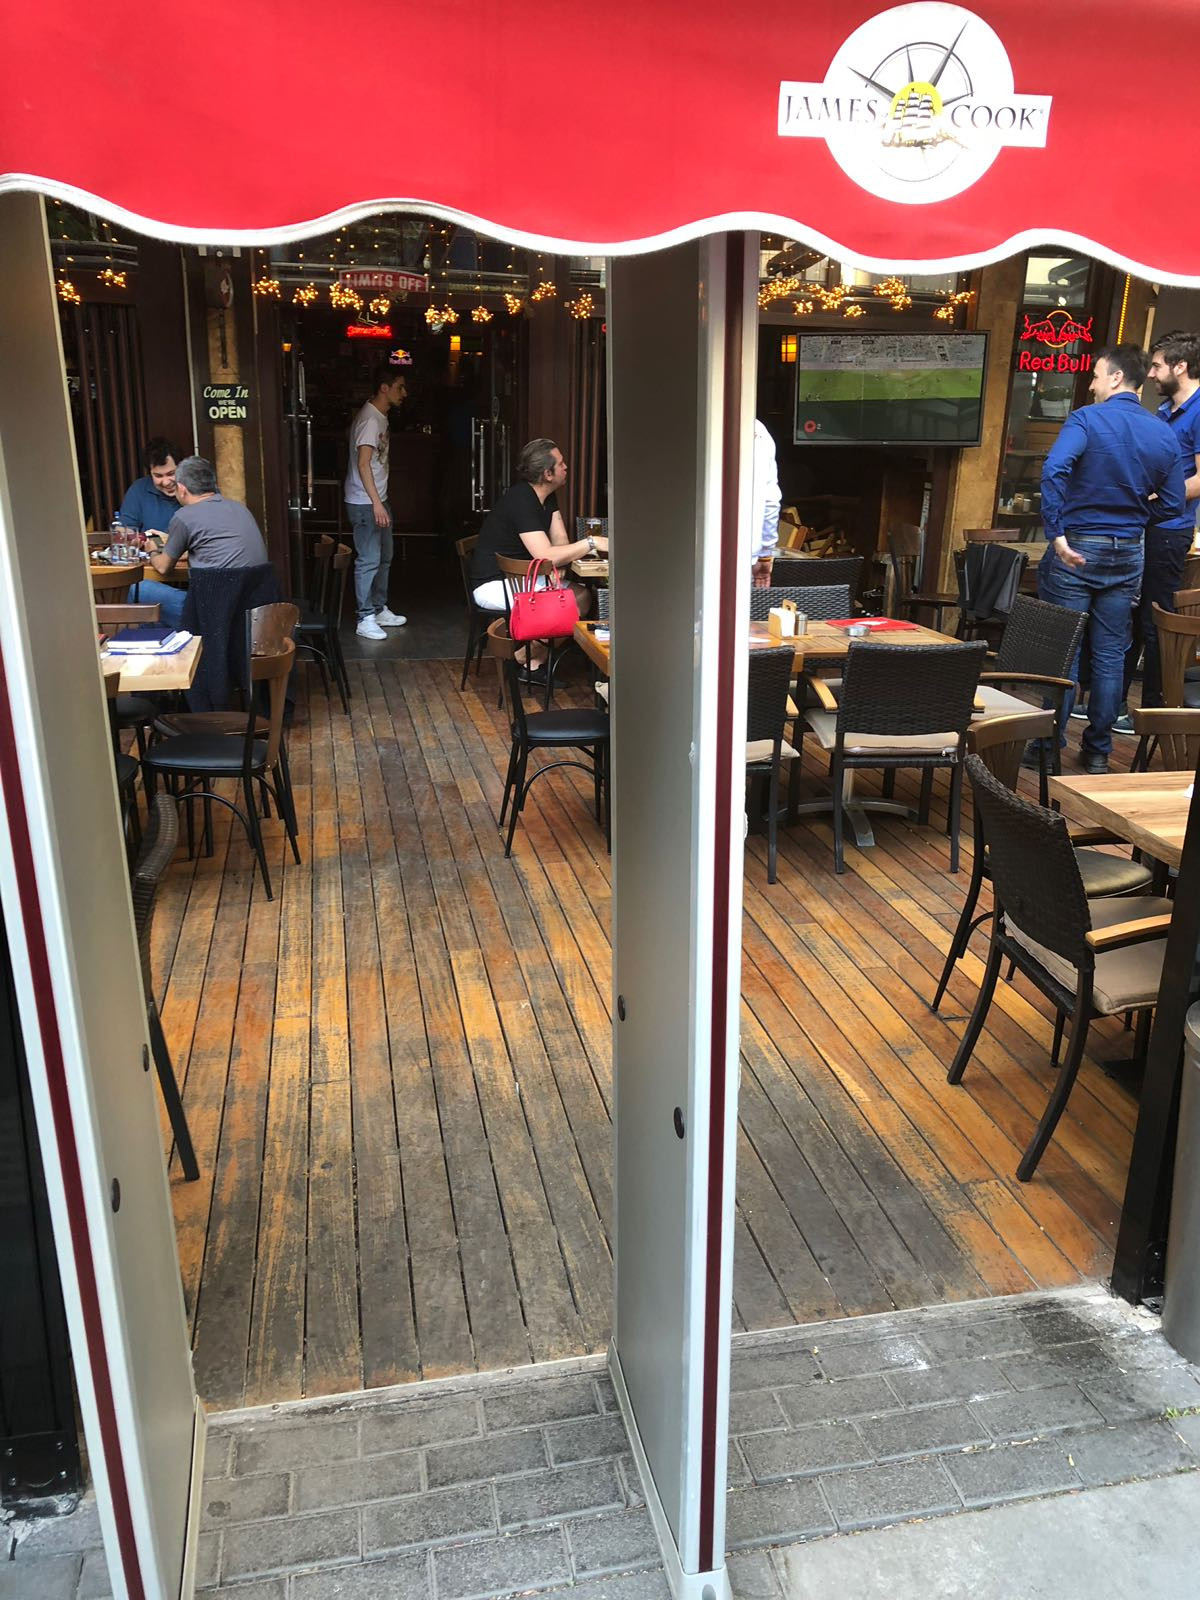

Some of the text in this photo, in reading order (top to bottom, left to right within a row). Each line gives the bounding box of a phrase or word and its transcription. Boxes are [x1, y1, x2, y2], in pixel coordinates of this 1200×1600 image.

[785, 95, 1037, 131] JAMES COOK
[399, 276, 423, 291] OFF
[1019, 351, 1092, 372] Red Bull
[203, 386, 249, 398] Come In
[209, 406, 247, 419] OPEN
